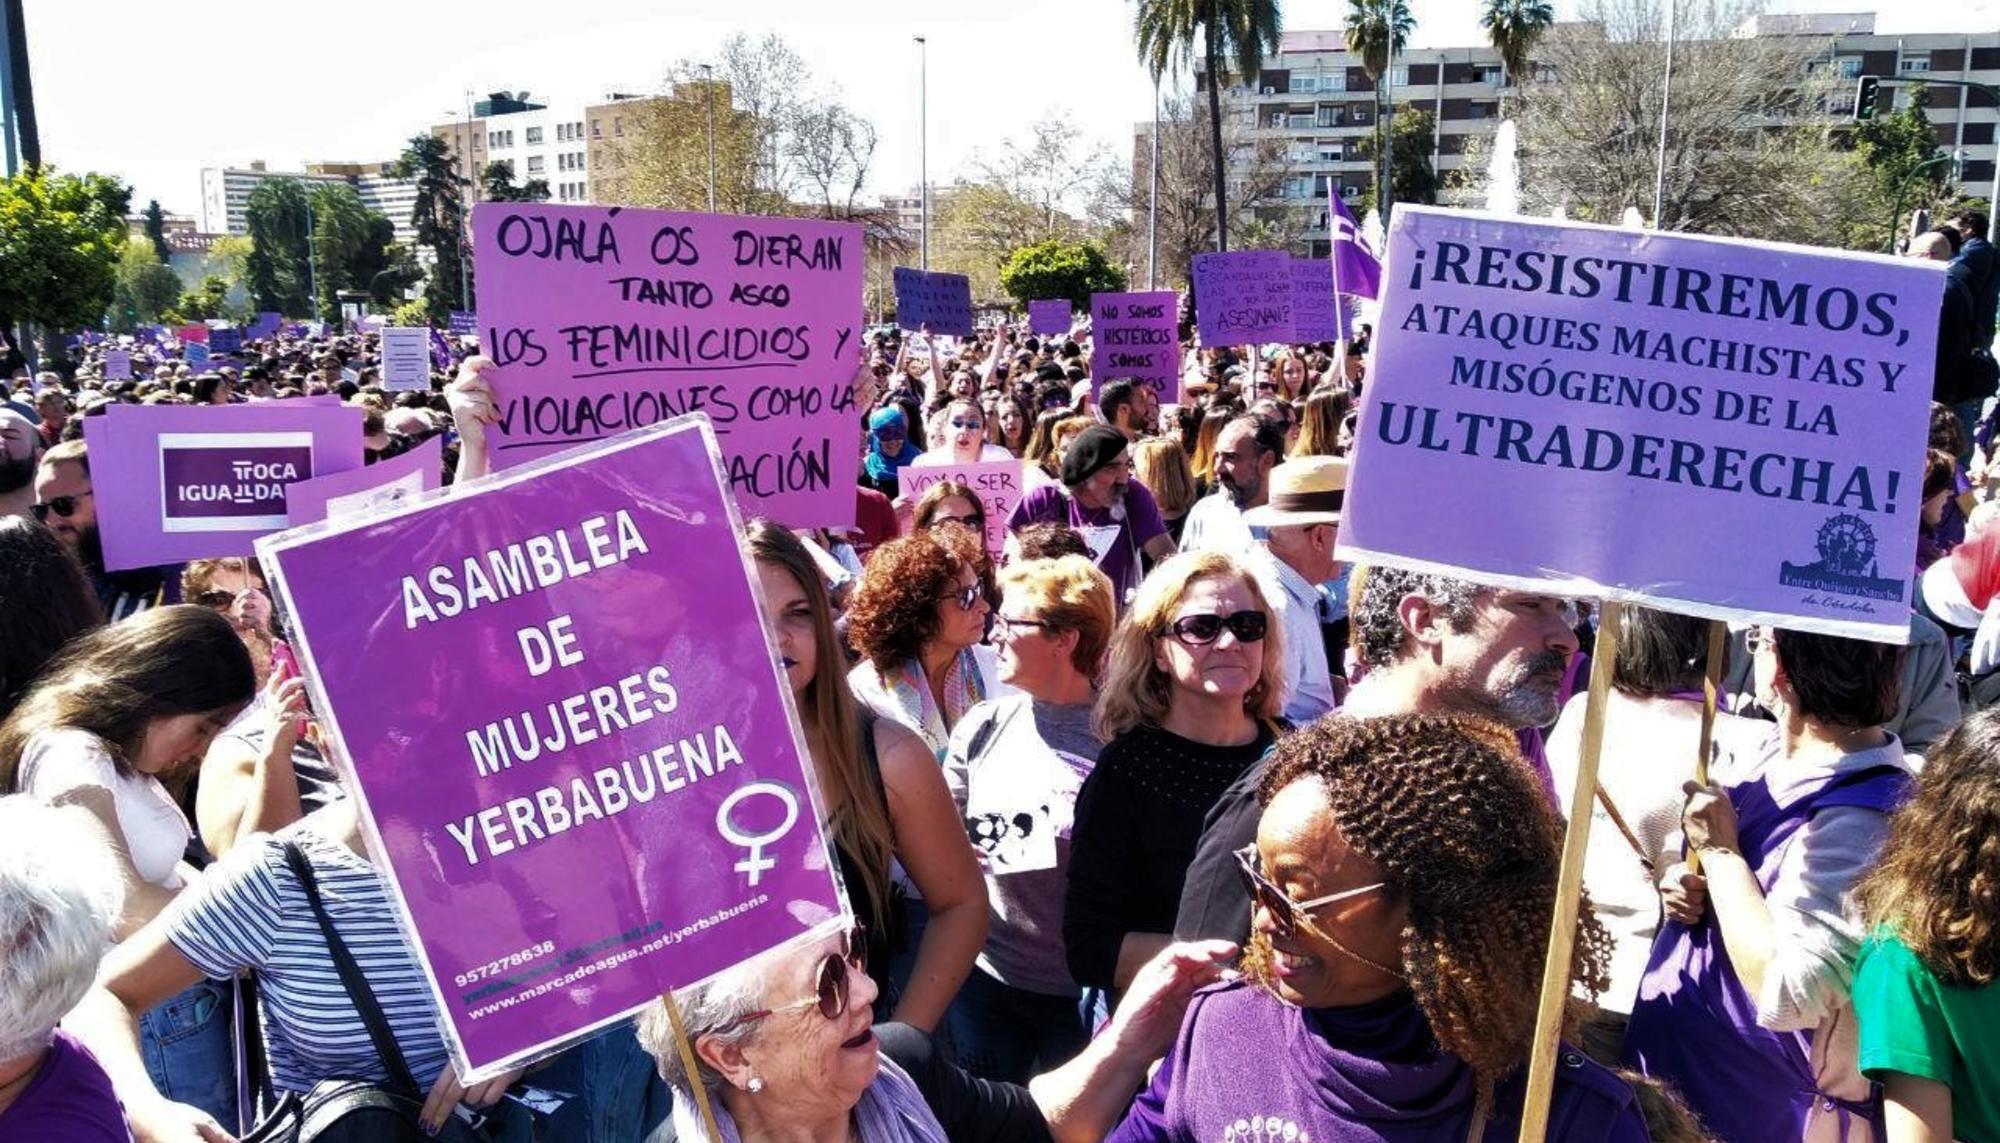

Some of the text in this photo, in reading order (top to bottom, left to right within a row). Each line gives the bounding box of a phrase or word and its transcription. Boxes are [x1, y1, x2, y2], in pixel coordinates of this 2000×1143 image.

[497, 207, 843, 271] OJALÁ OS DIERAN
[610, 277, 790, 309] TANTO ASCO
[1101, 304, 1164, 319] NO SOMOS
[1217, 304, 1290, 330] ASESINAN?
[1410, 241, 1911, 348] ¡RESISTIREMOS,
[490, 323, 851, 367] LOS FEMINICIDIOS Y
[1109, 353, 1154, 368] SOMOS
[1401, 302, 1907, 393] ATAQUES MACHISTAS Y
[494, 383, 857, 436] VIOLACIONES COMO LA
[1450, 355, 1839, 436] MISÓGENOS DE LA
[727, 437, 830, 498] ACIÓN
[975, 472, 1017, 491] SER
[1378, 402, 1902, 514] ULTRADERECHA!
[178, 483, 286, 503] IGUALDA
[983, 497, 1008, 518] ER
[401, 509, 649, 630] ASAMBLEA
[1861, 585, 1901, 601] Sancho
[516, 614, 586, 677] DE
[465, 665, 679, 778] MUJERES
[445, 724, 745, 865] YERBABUENA
[454, 940, 555, 988] 957278638
